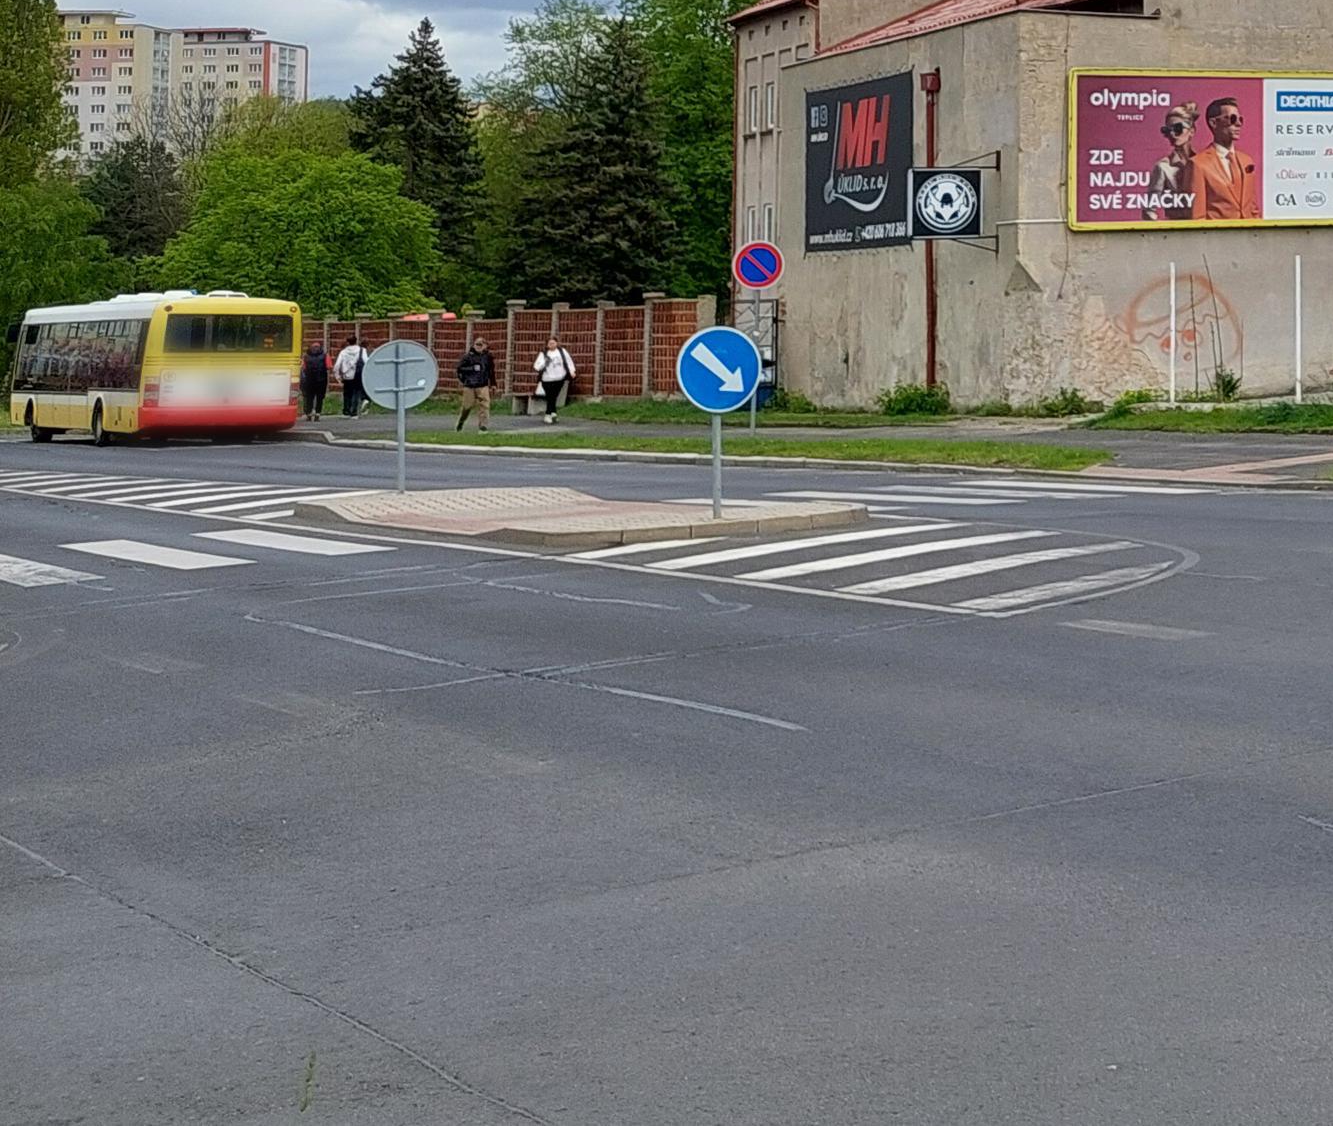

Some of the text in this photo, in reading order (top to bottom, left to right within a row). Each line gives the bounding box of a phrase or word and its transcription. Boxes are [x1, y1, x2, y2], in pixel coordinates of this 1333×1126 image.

[1090, 88, 1171, 110] olympia
[836, 94, 890, 171] MH
[1089, 149, 1124, 165] ZDE
[837, 173, 863, 193] ÚKLID
[1089, 172, 1151, 187] NAJDU
[1089, 189, 1196, 210] SVÉ ZNAČKY
